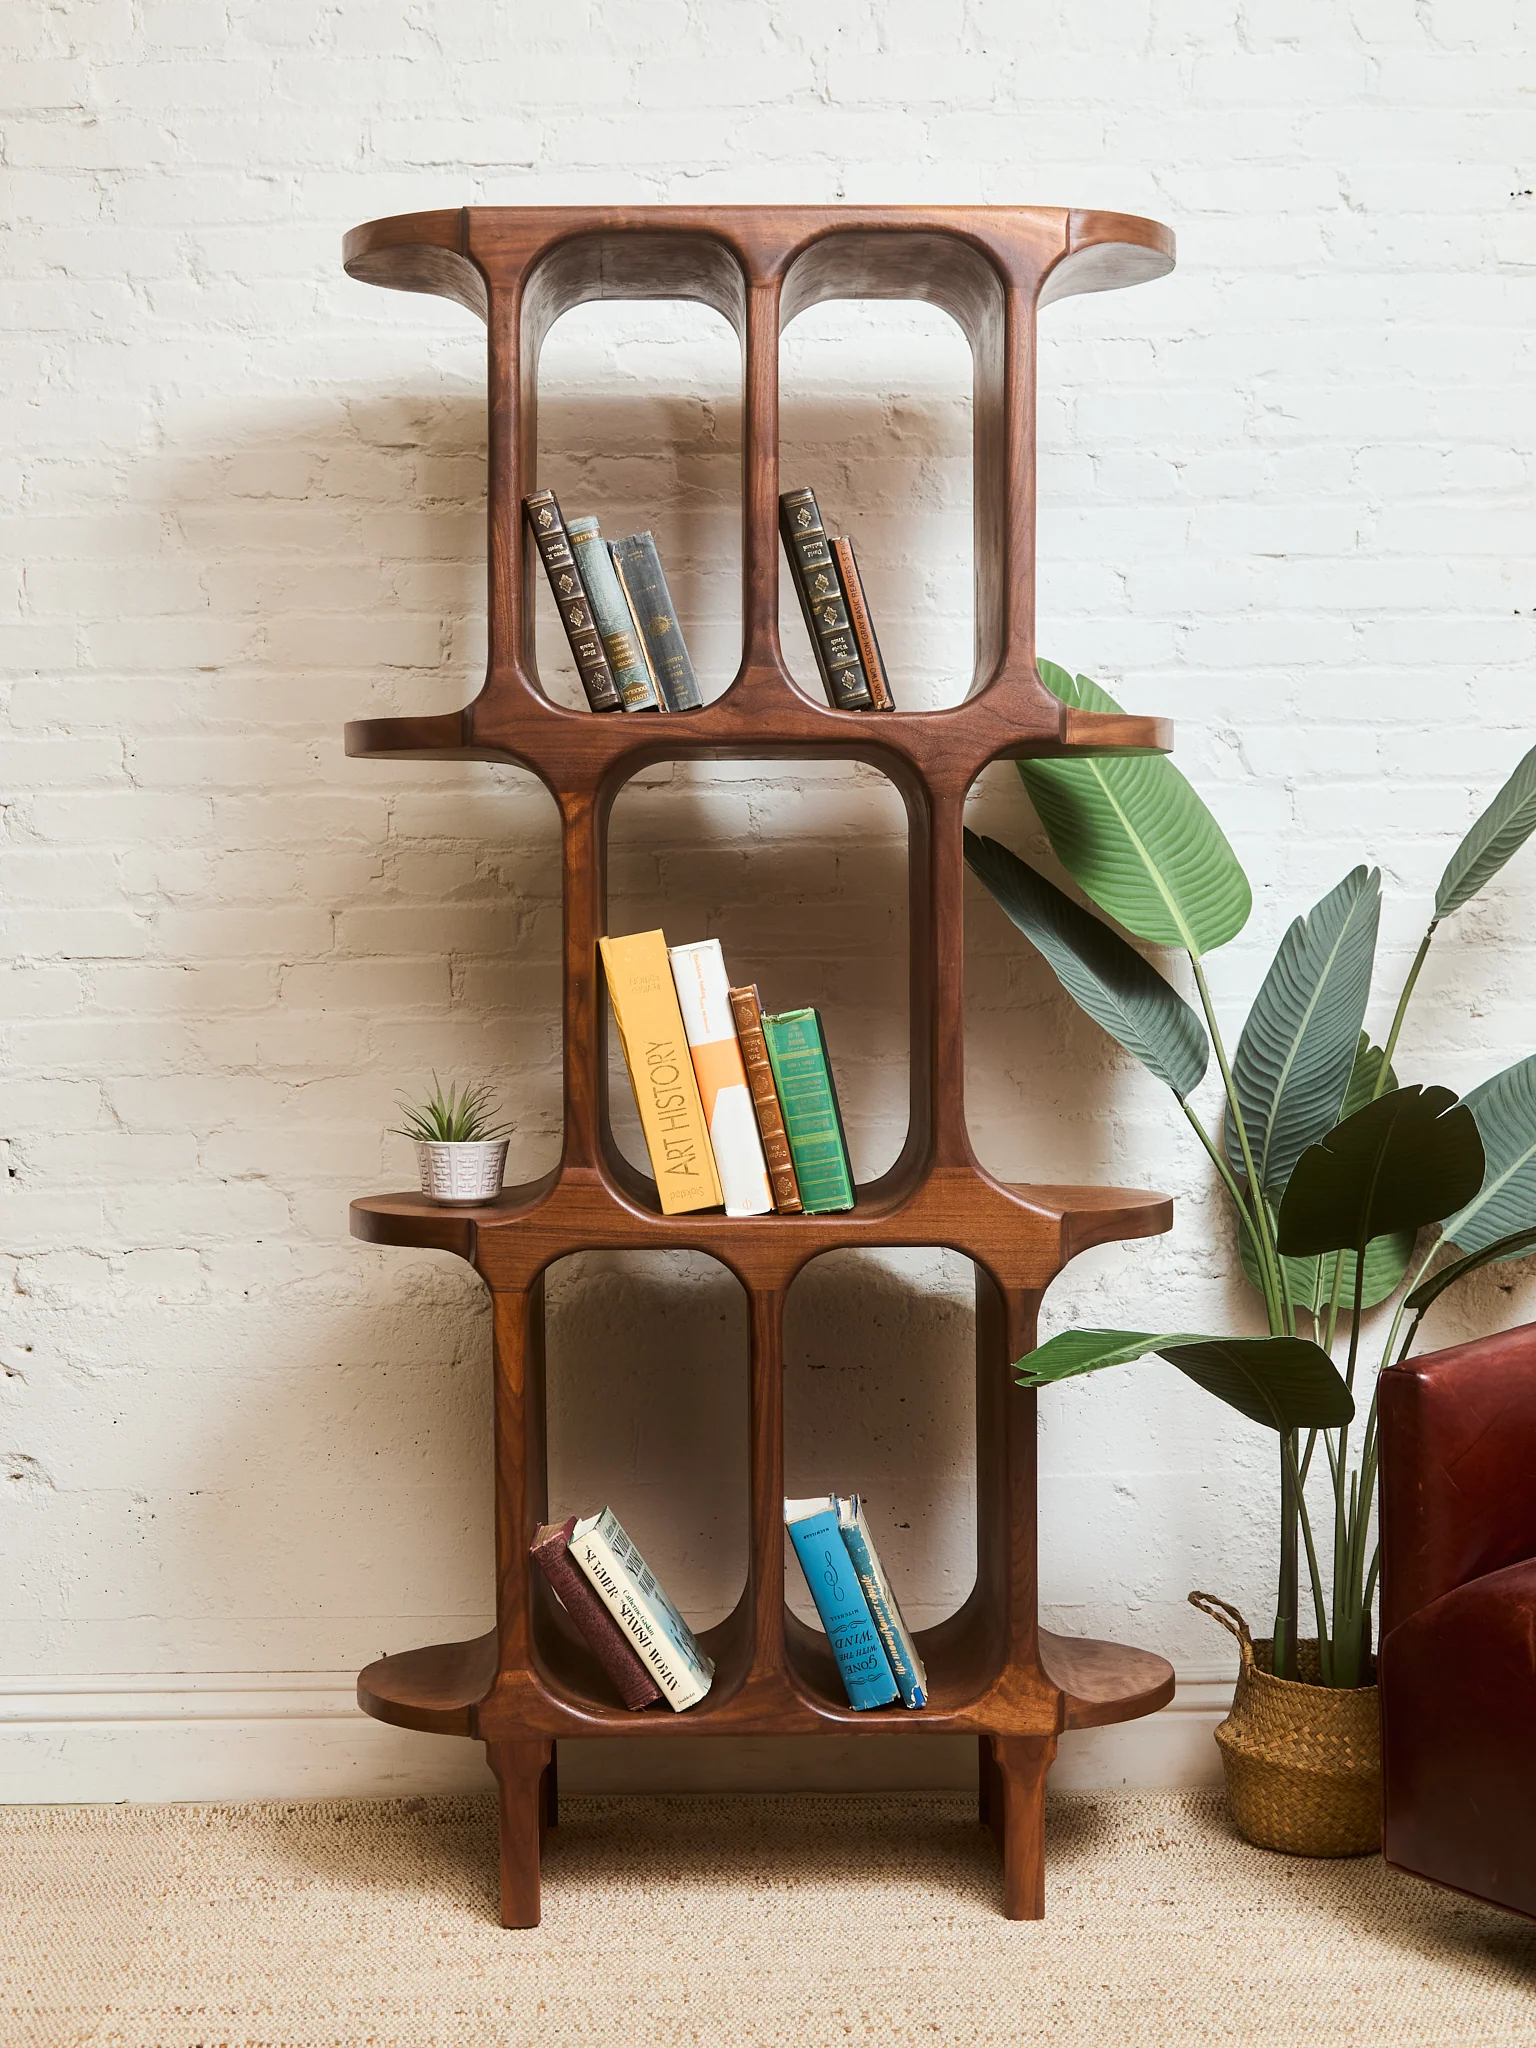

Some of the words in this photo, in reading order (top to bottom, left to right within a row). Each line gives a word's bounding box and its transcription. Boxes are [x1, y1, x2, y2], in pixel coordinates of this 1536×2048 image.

[845, 564, 858, 597] READERS
[852, 598, 863, 619] BASIC
[869, 667, 878, 682] TWO
[631, 692, 649, 701] LLOYD
[645, 1039, 691, 1132] HISTORY
[663, 1137, 700, 1177] ART
[669, 1186, 704, 1202] Stokstad
[802, 1527, 830, 1539] MACMILLAN
[584, 1549, 619, 1598] SUMMER
[619, 1602, 652, 1648] SPANISH
[648, 1648, 680, 1691] WOMAN
[624, 1590, 642, 1617] Catherine
[640, 1615, 655, 1636] Gaskin
[829, 1608, 859, 1621] MITCHELL
[834, 1630, 873, 1648] WIND
[838, 1651, 854, 1661] THE
[855, 1645, 877, 1657] WITH
[845, 1654, 877, 1673] GONE
[892, 1658, 907, 1676] the
